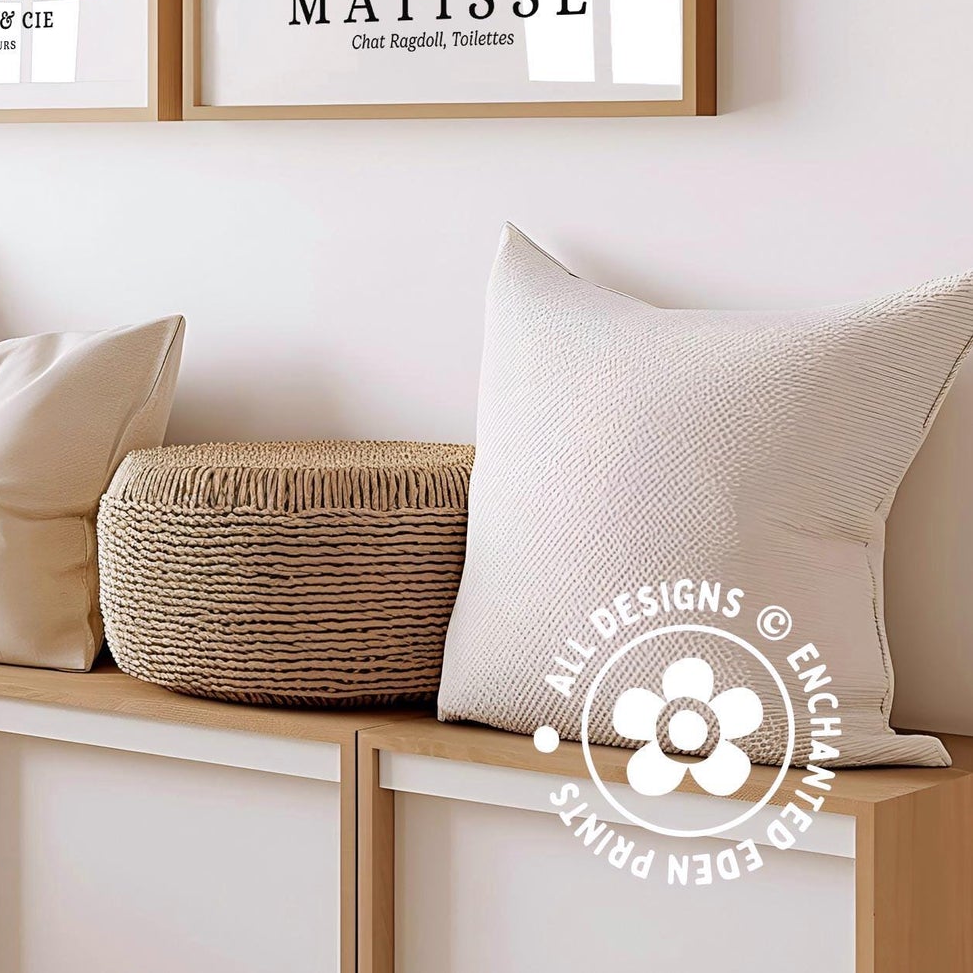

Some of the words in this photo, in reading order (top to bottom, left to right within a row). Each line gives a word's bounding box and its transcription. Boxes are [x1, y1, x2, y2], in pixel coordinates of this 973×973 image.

[0, 11, 15, 29] &
[22, 11, 54, 29] CIE
[351, 34, 385, 50] Chat
[389, 32, 447, 53] Ragdoll,
[452, 30, 514, 47] Toilettes
